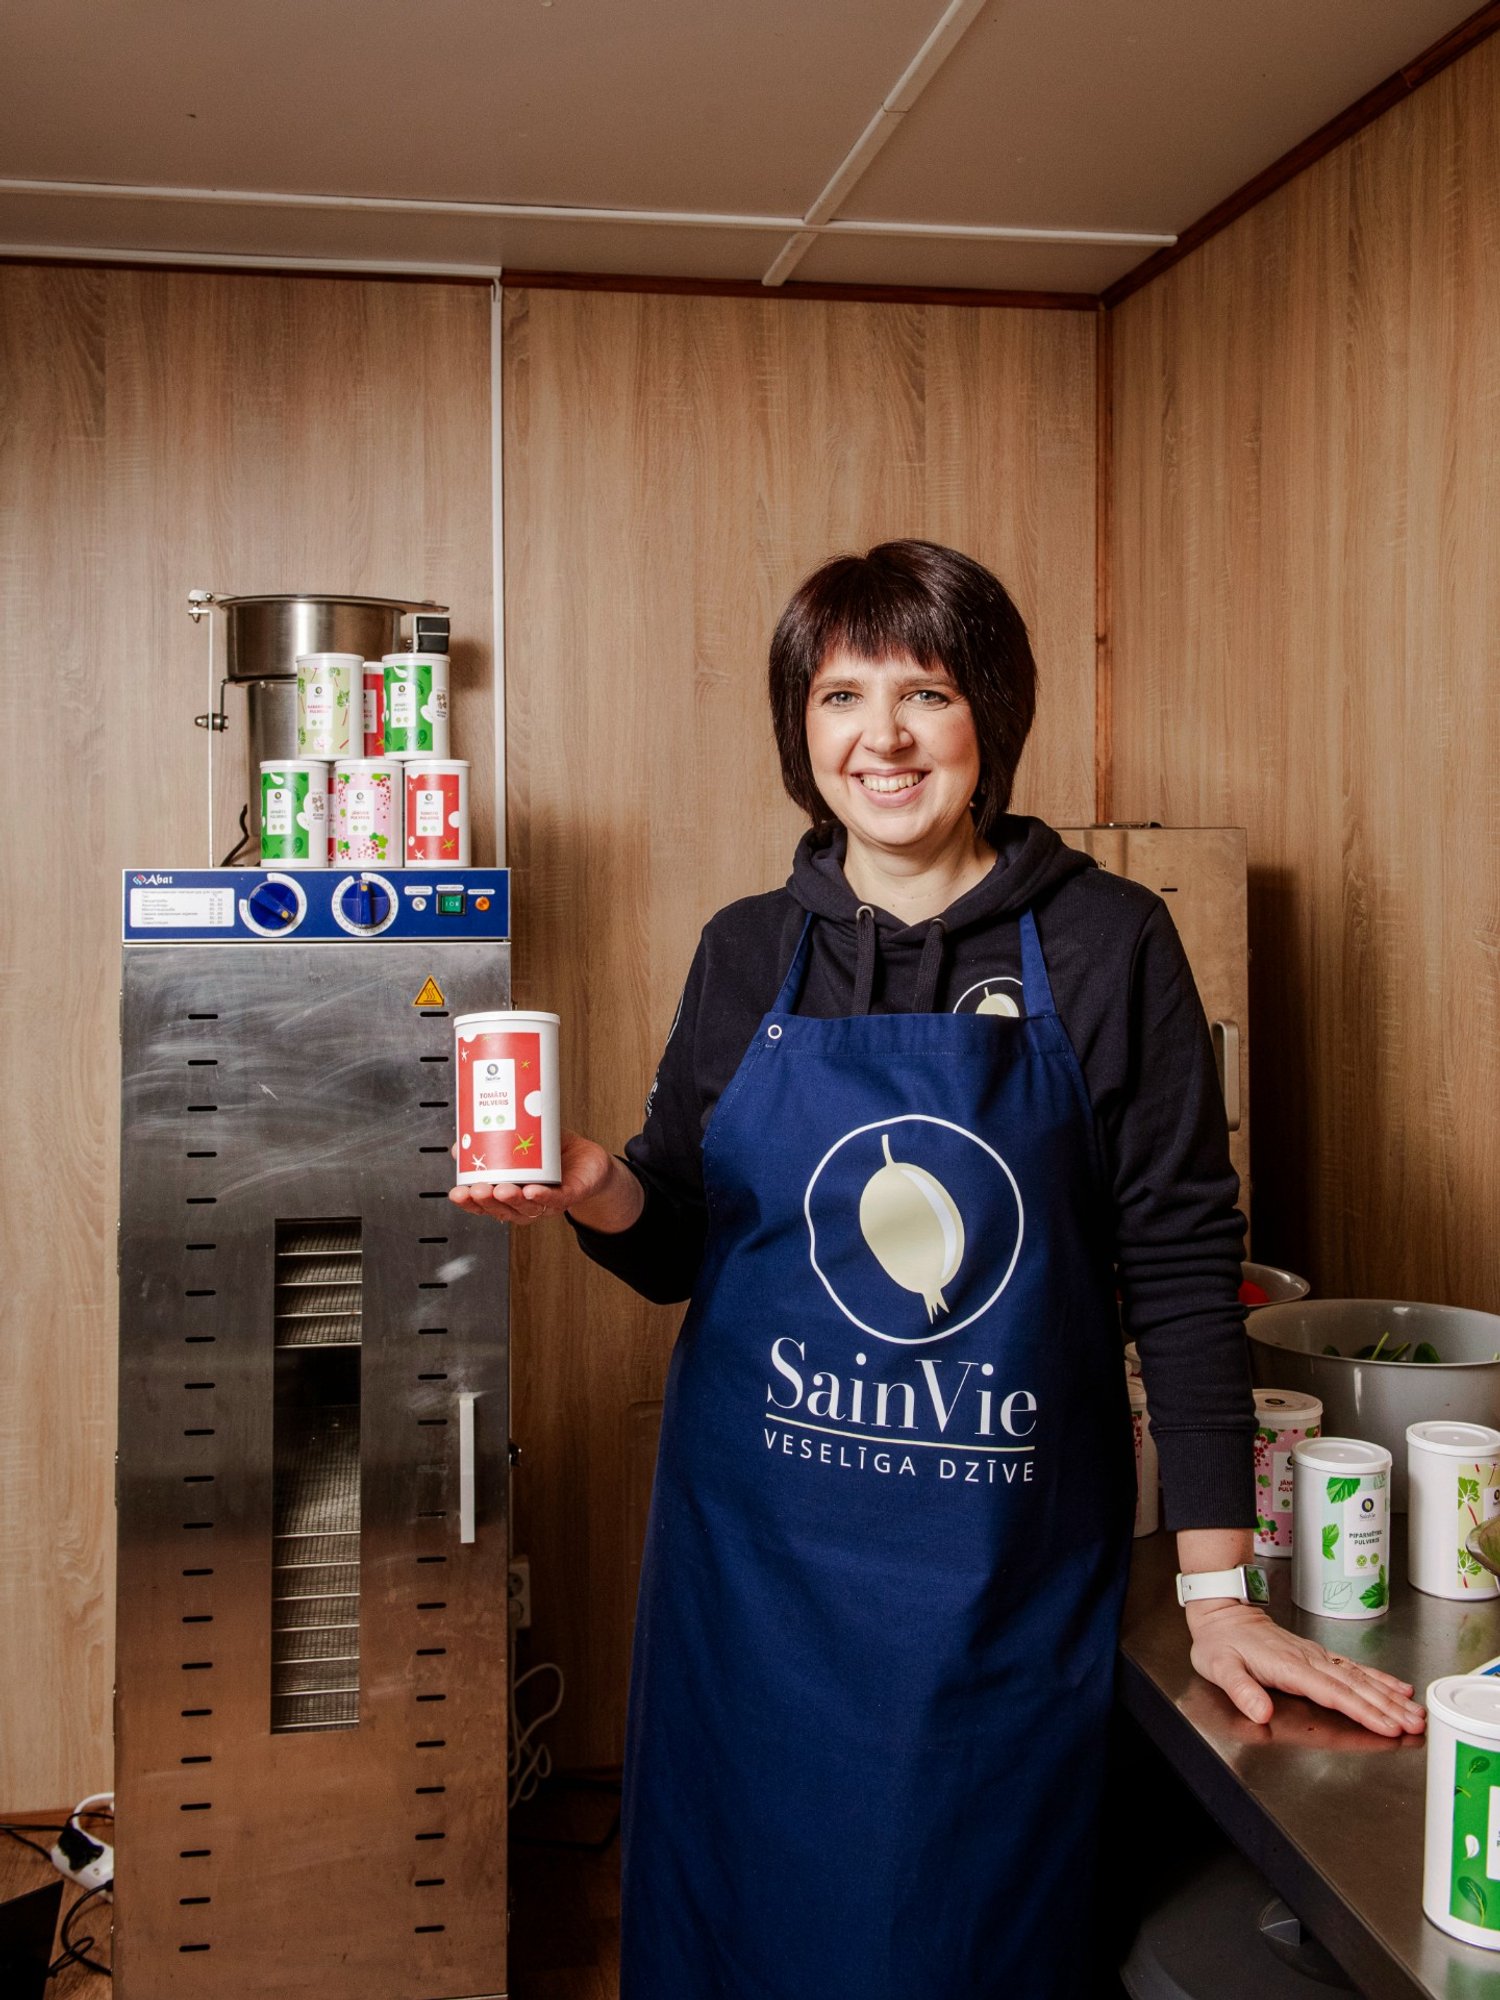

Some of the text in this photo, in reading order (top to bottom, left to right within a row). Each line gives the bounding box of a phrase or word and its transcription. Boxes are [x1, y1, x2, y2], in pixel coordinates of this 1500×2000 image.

[145, 873, 172, 885] Abat
[480, 1091, 508, 1099] TOMĀTU
[479, 1098, 509, 1107] PULVERIS
[767, 1337, 1037, 1437] SainVie
[764, 1428, 1035, 1483] VESELĪGA DZĪVE
